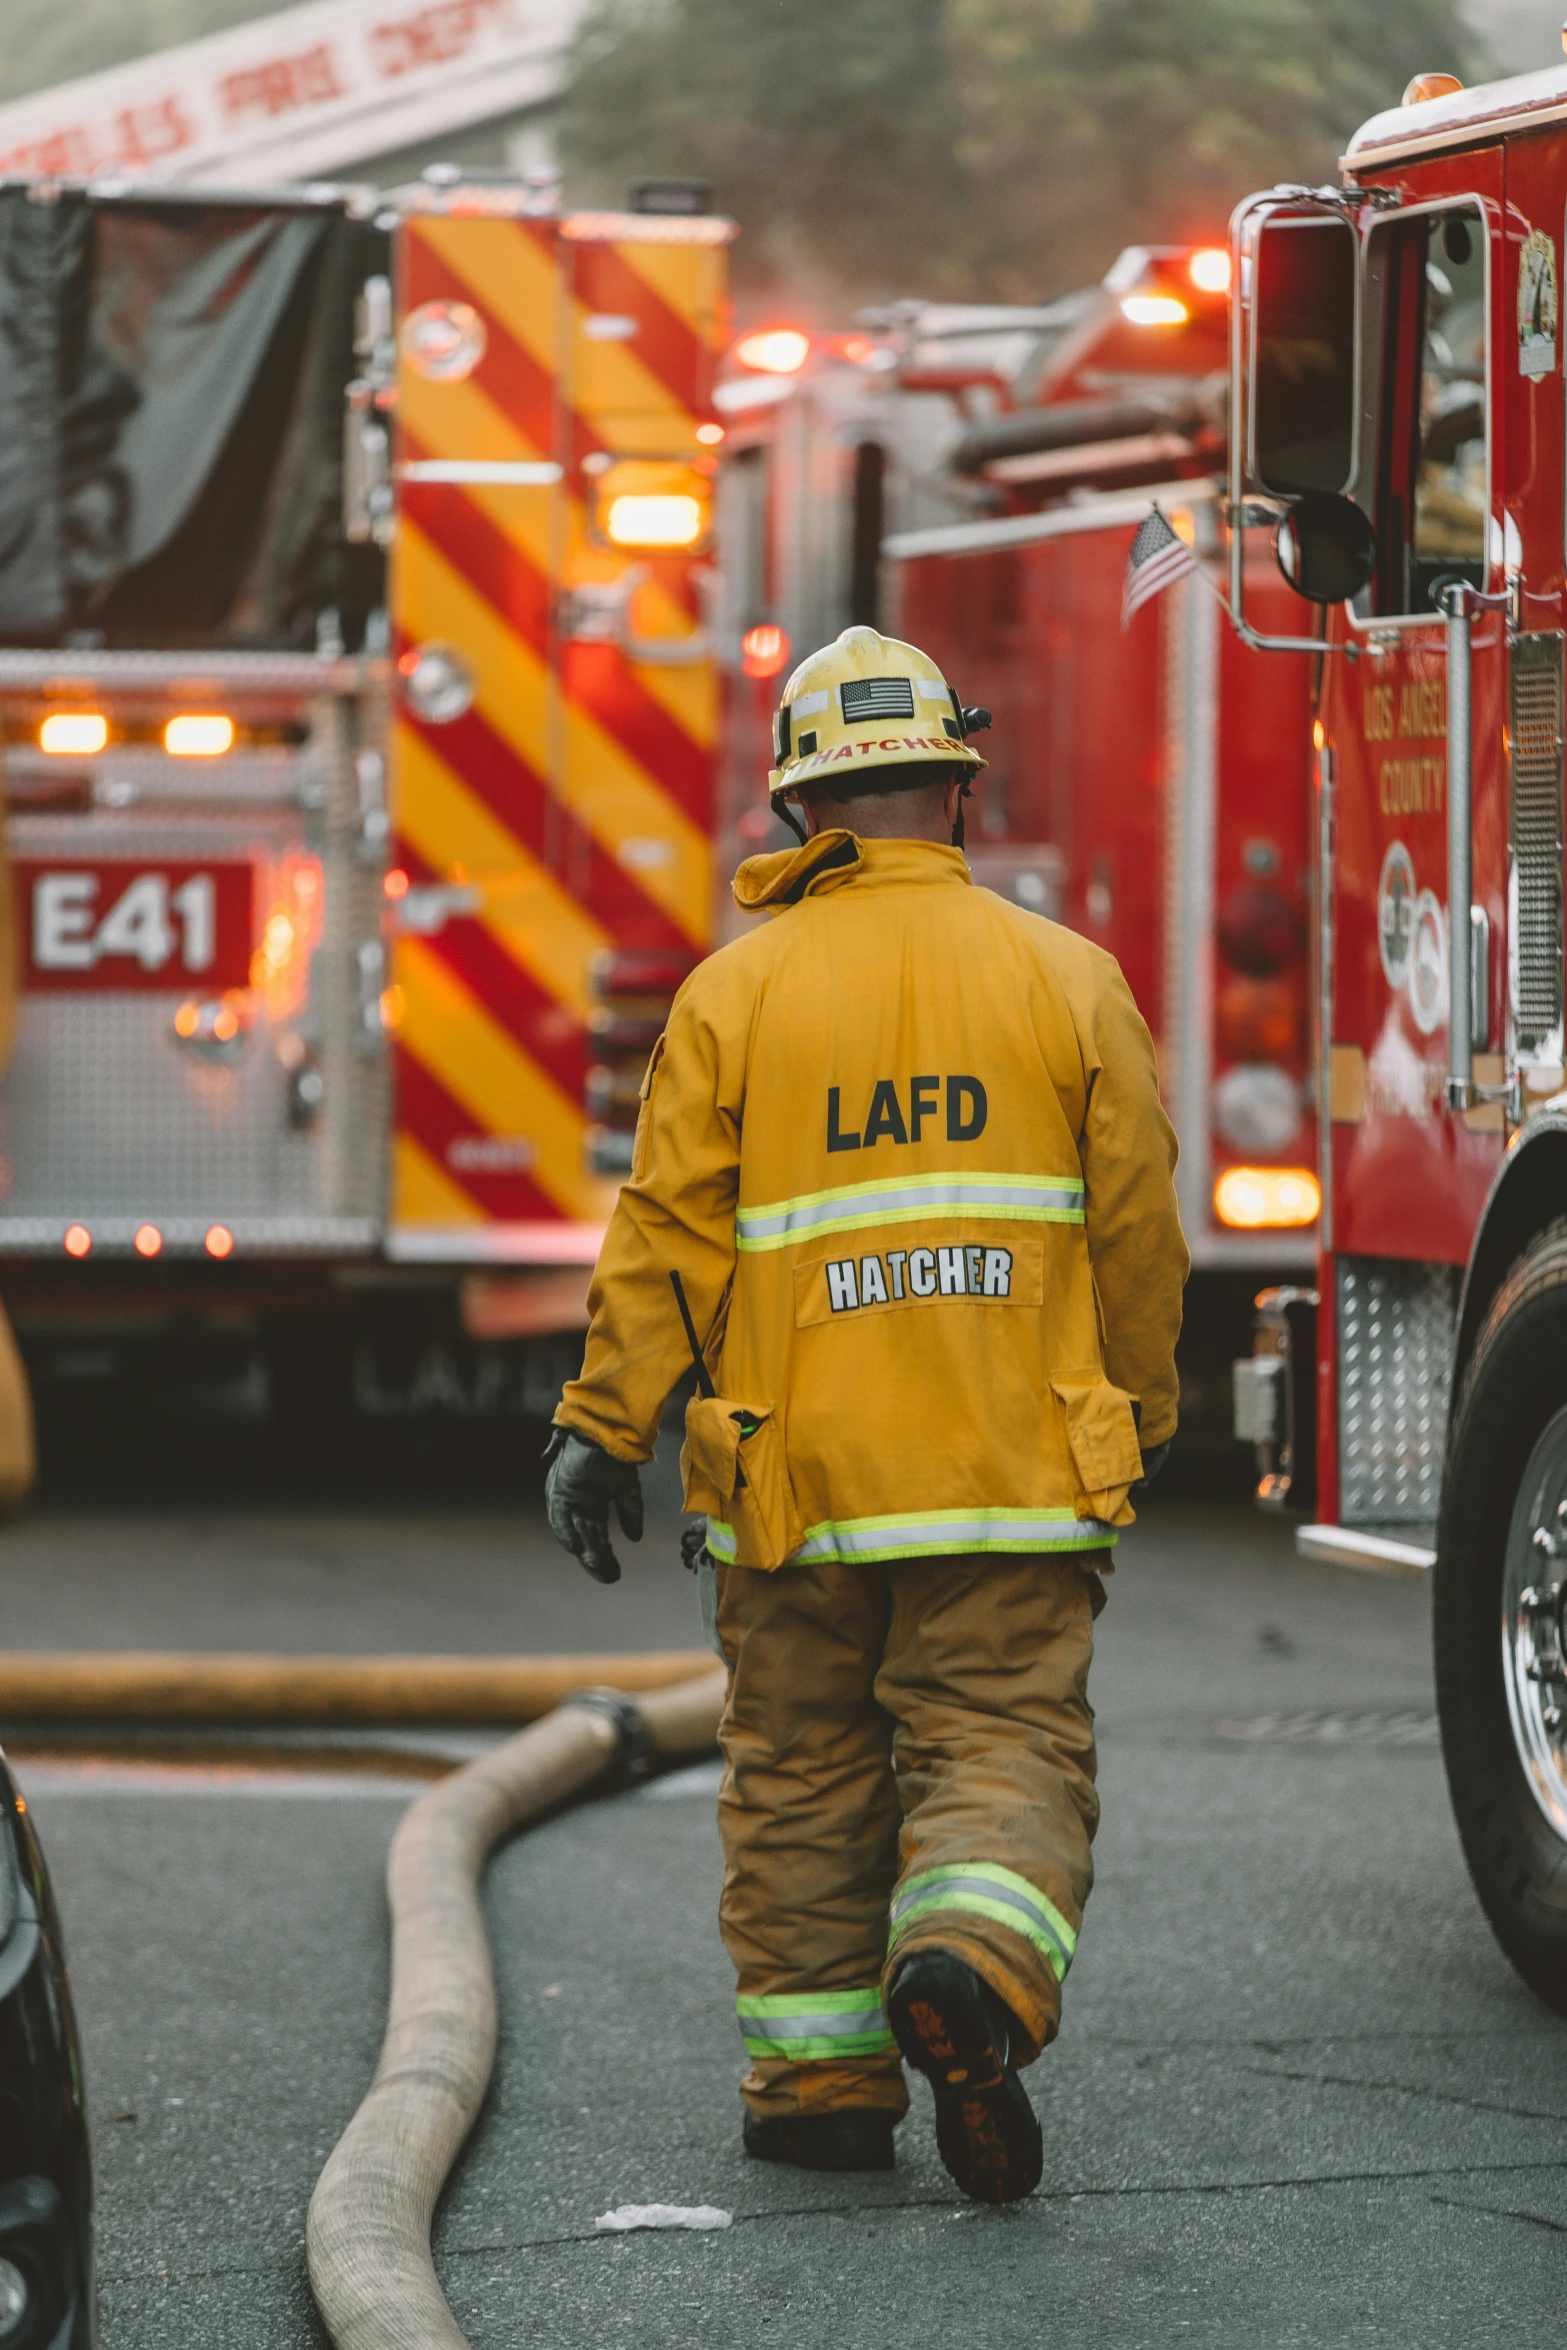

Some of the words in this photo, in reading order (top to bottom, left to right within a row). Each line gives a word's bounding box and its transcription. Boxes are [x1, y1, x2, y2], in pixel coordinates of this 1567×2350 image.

[1364, 684, 1394, 742] LOS
[1399, 680, 1448, 738] ANGEL
[810, 737, 968, 768] HATCHER
[1380, 757, 1446, 816] COUNTY
[33, 870, 216, 973] E41
[826, 1075, 988, 1153] LAFD
[825, 1245, 1013, 1314] HATCHER
